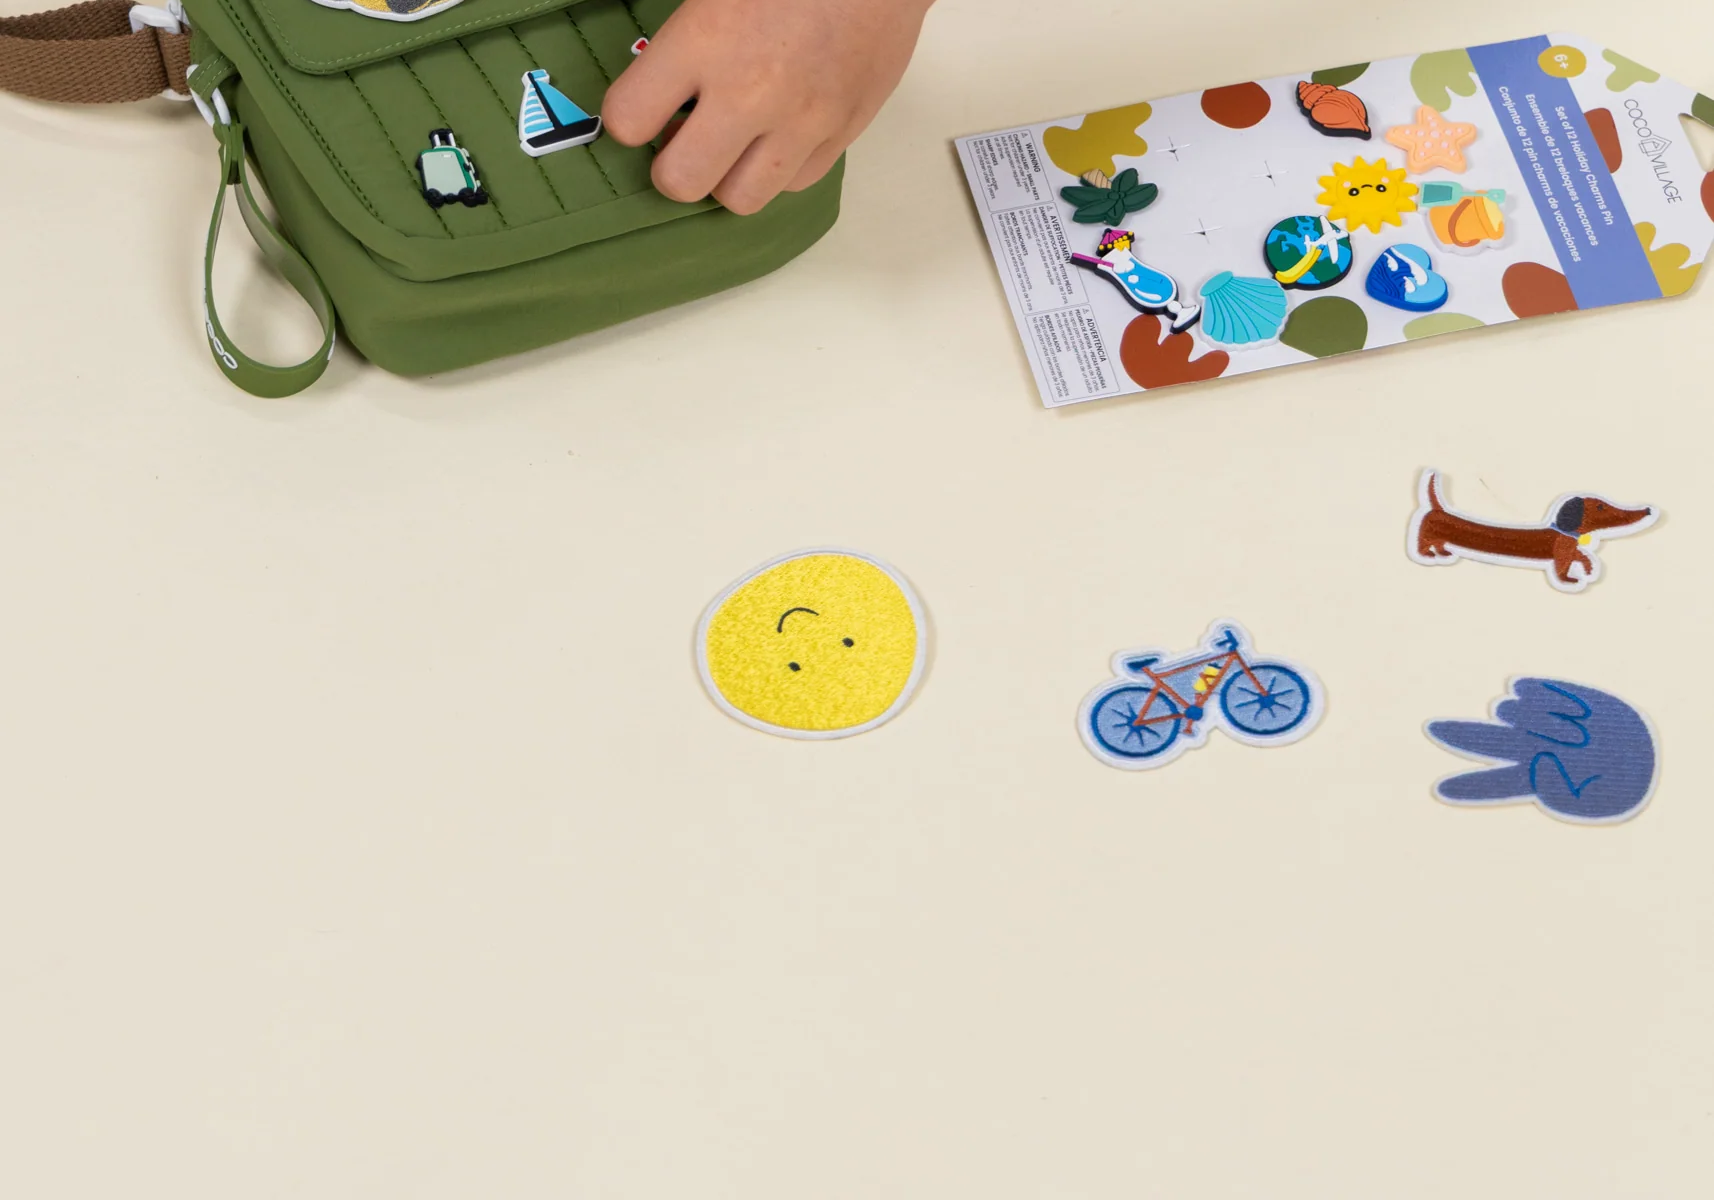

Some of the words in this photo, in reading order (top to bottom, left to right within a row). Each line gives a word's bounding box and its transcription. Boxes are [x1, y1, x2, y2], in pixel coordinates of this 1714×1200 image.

[1554, 54, 1569, 69] 6+
[1499, 86, 1521, 125] Conjunto
[1525, 94, 1549, 134] Ensemble
[1555, 106, 1568, 120] Set
[1516, 126, 1527, 137] de
[1562, 121, 1574, 130] of
[1566, 131, 1577, 139] 12
[1522, 138, 1533, 146] 12
[1545, 135, 1555, 147] de
[1550, 148, 1561, 156] 12
[1624, 99, 1652, 138] COCO
[1651, 155, 1682, 204] VILLAGE
[1025, 143, 1041, 172] WARNING
[1523, 148, 1538, 162] pin
[1570, 140, 1591, 172] Holiday
[1533, 163, 1553, 196] charms
[1554, 157, 1579, 201] breloques
[1548, 197, 1558, 209] de
[1586, 174, 1607, 210] Charms
[1574, 202, 1598, 246] vacances
[1601, 211, 1613, 225] Pin
[1554, 210, 1581, 262] vacaciones
[1086, 319, 1106, 362] ADVERTENCIA
